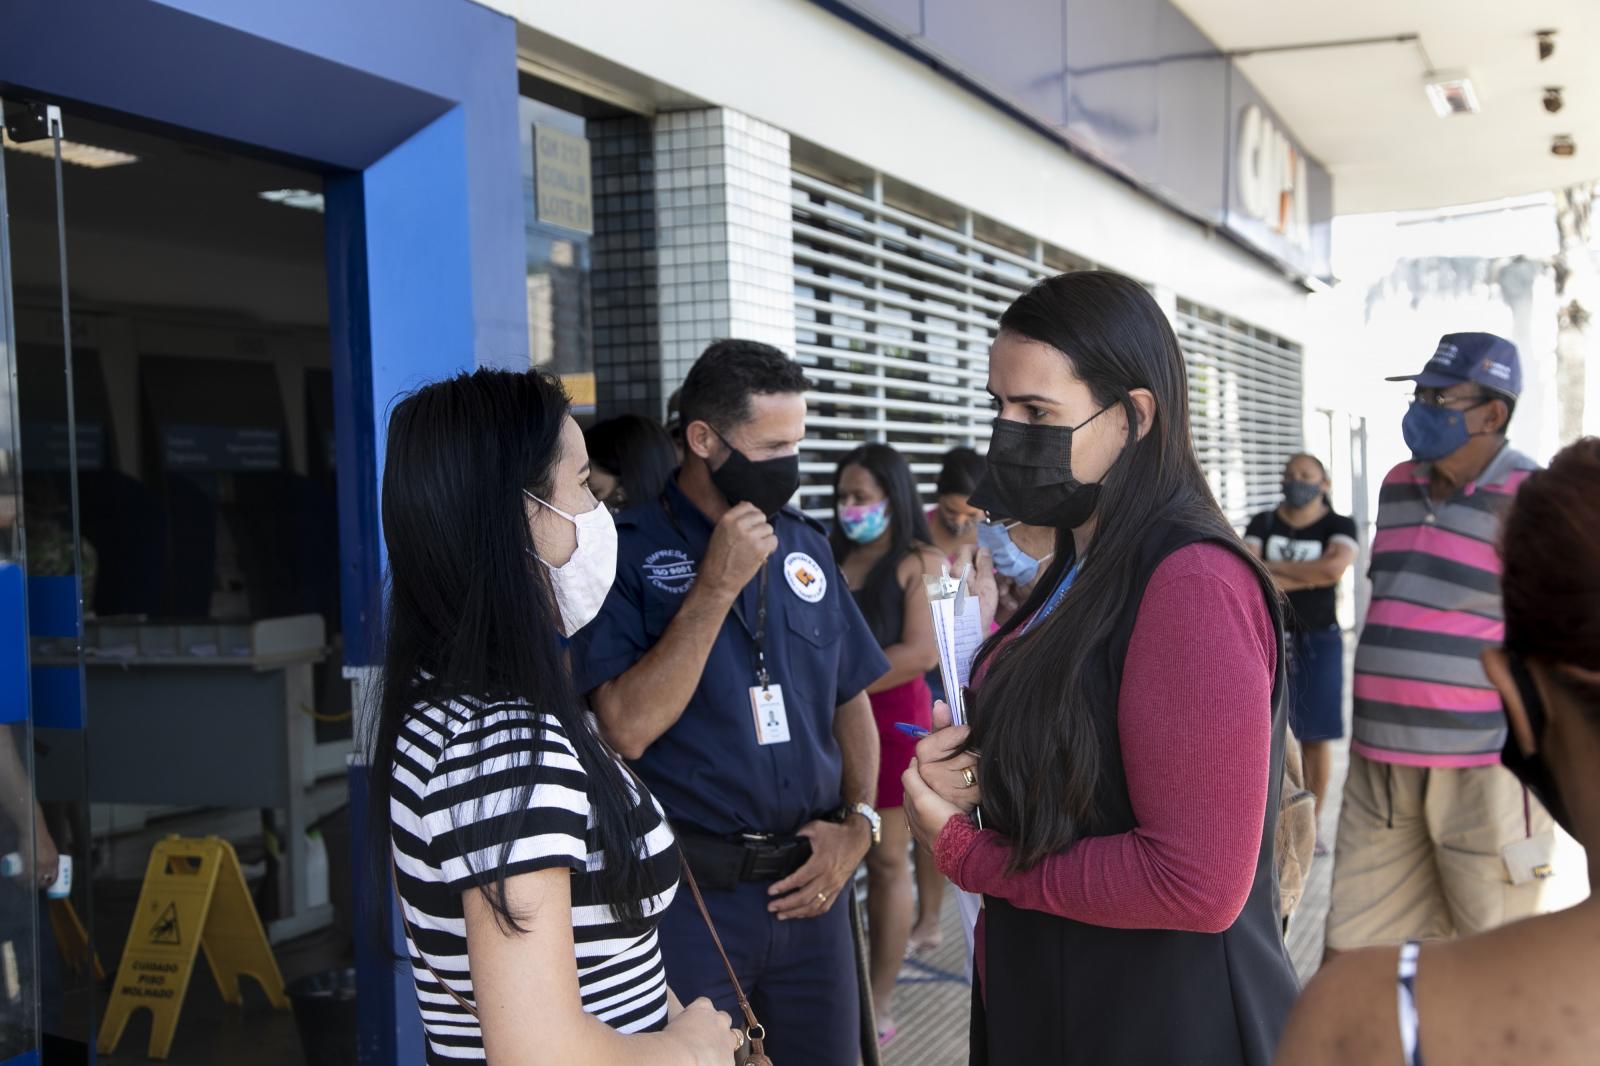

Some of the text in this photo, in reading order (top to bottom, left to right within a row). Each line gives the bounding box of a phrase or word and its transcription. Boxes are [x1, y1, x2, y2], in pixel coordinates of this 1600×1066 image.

[645, 549, 687, 564] EMPRESA
[669, 565, 692, 575] 9001
[131, 960, 179, 973] CUIDADO
[137, 974, 165, 986] PISO
[122, 986, 175, 999] MOLHADO
